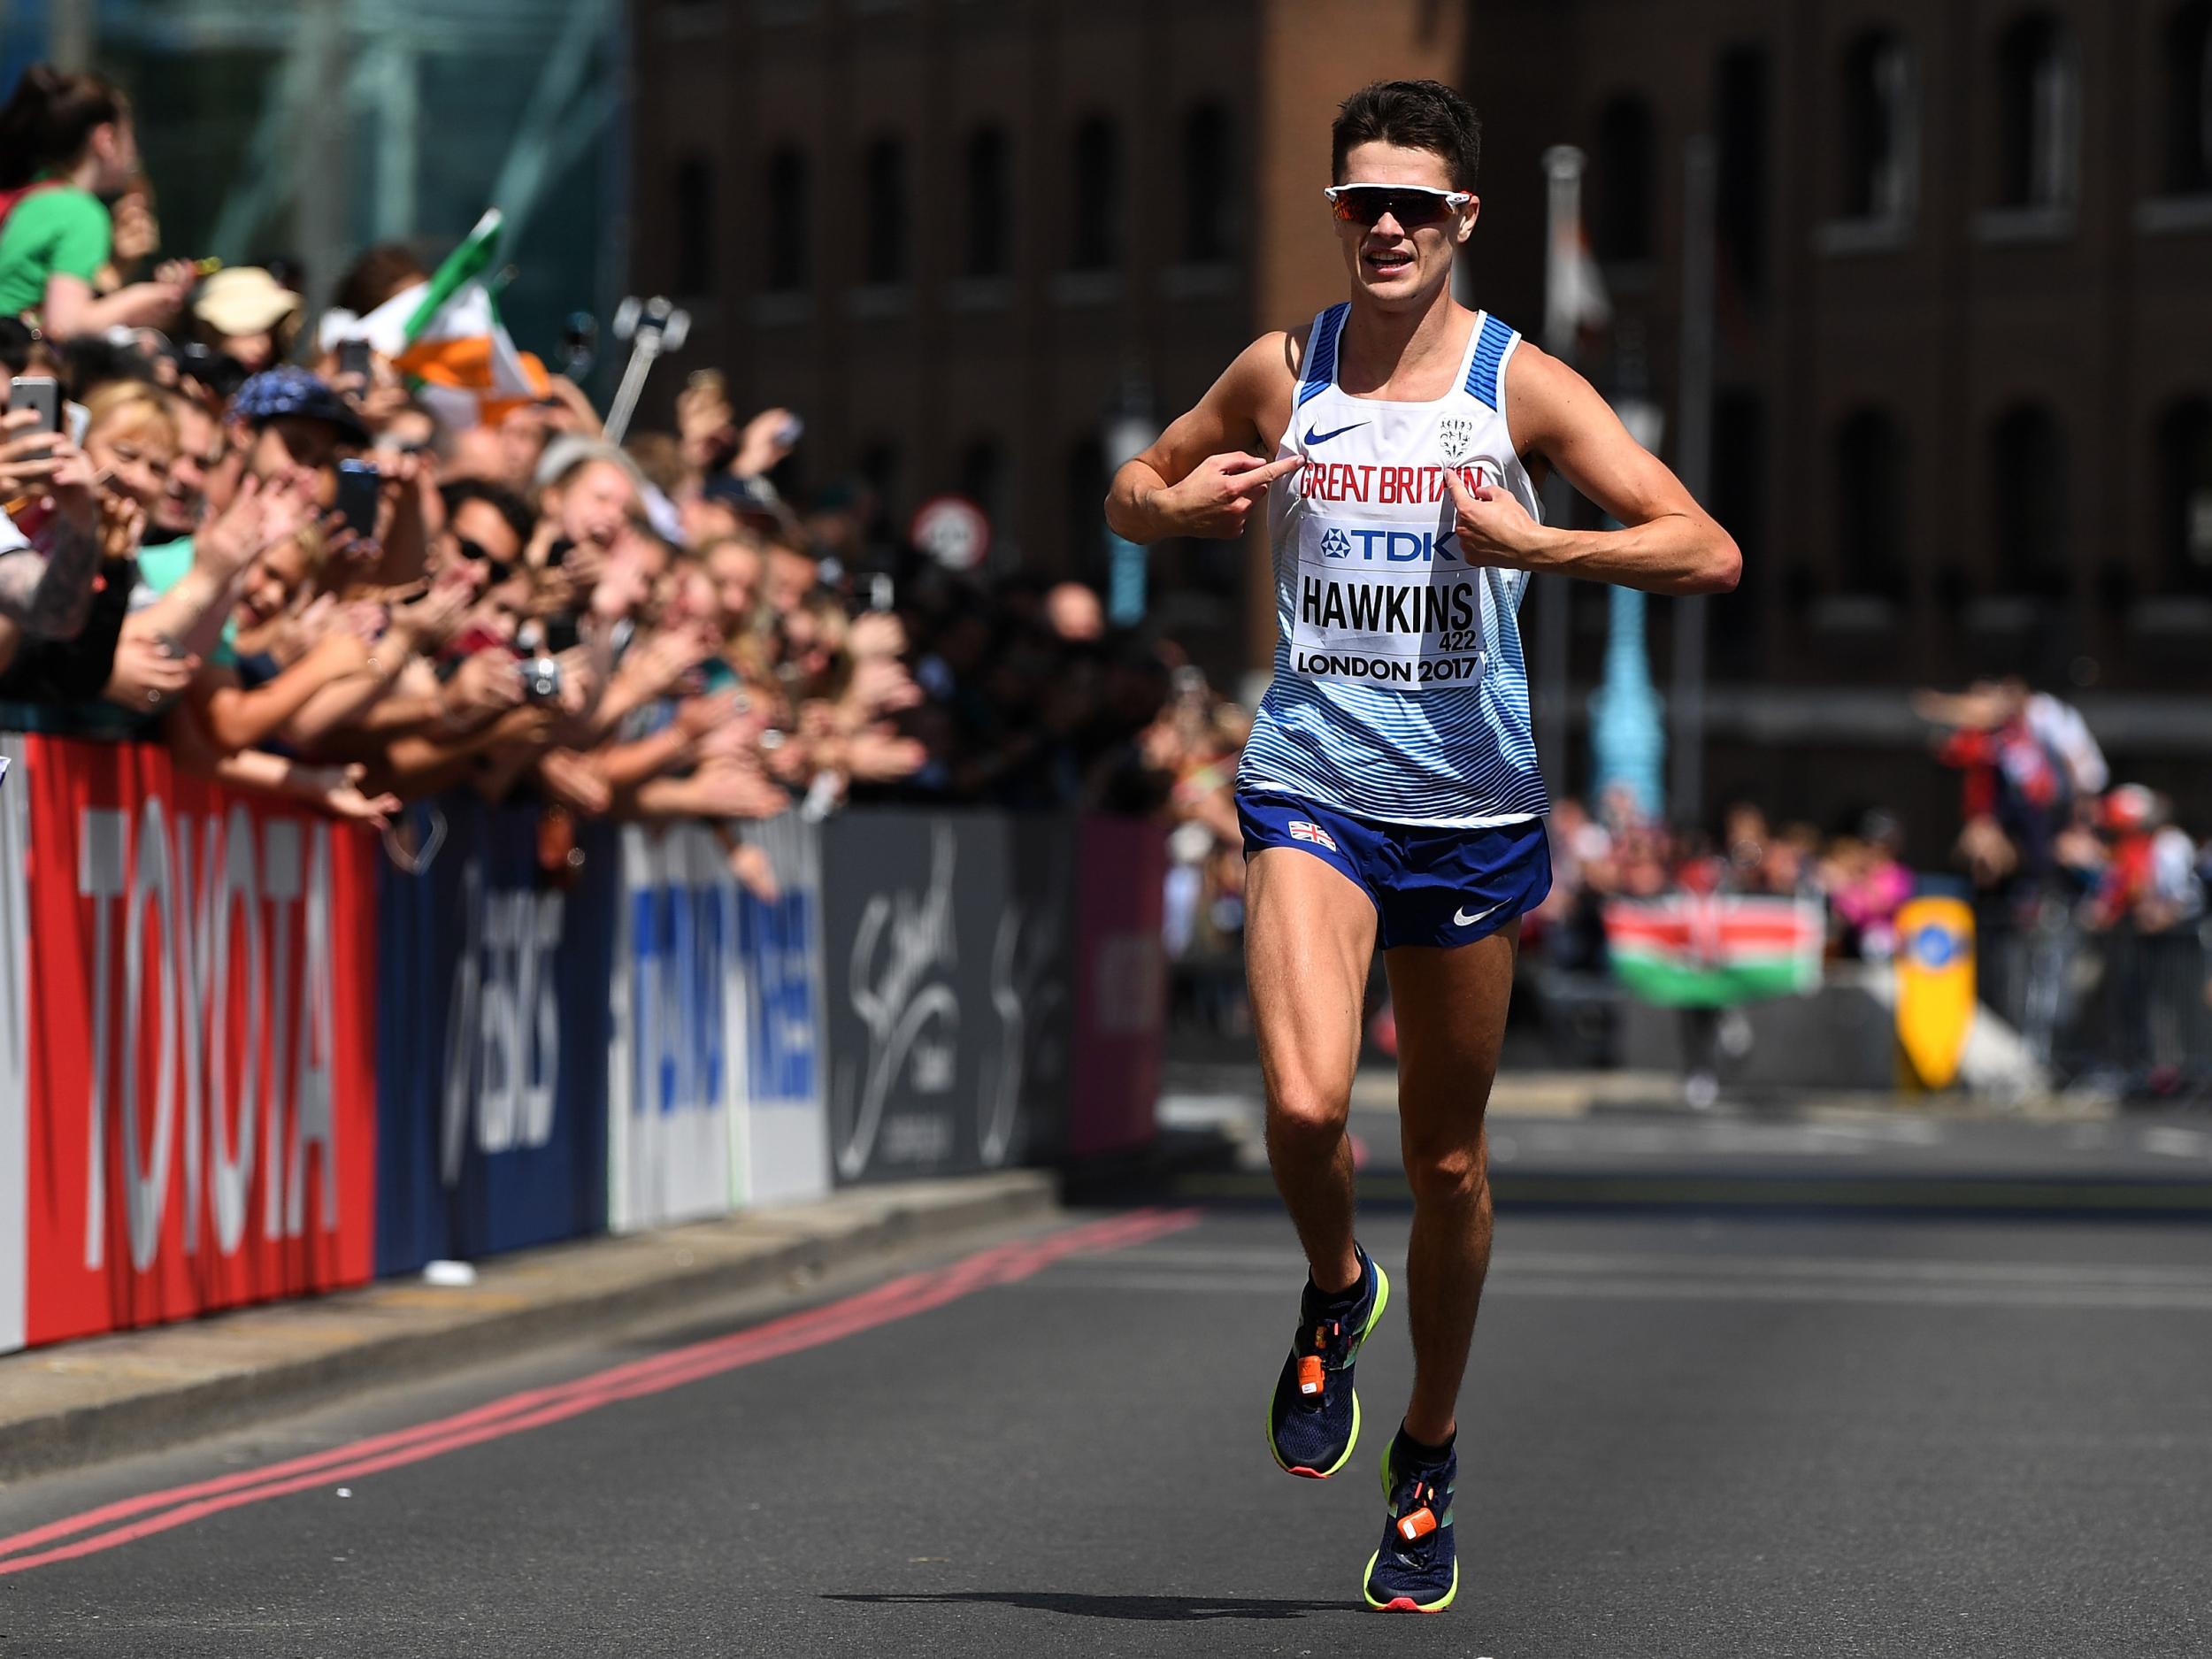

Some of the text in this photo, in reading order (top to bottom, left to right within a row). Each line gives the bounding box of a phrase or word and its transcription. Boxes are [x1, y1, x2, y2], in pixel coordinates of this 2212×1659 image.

[1300, 462, 1377, 503] GREAT
[1350, 529, 1457, 562] TDK
[1302, 575, 1473, 634] HAWKINS
[1439, 629, 1477, 652] 422
[1297, 652, 1479, 682] LONDON 2017
[79, 795, 338, 1272] TOYOTA
